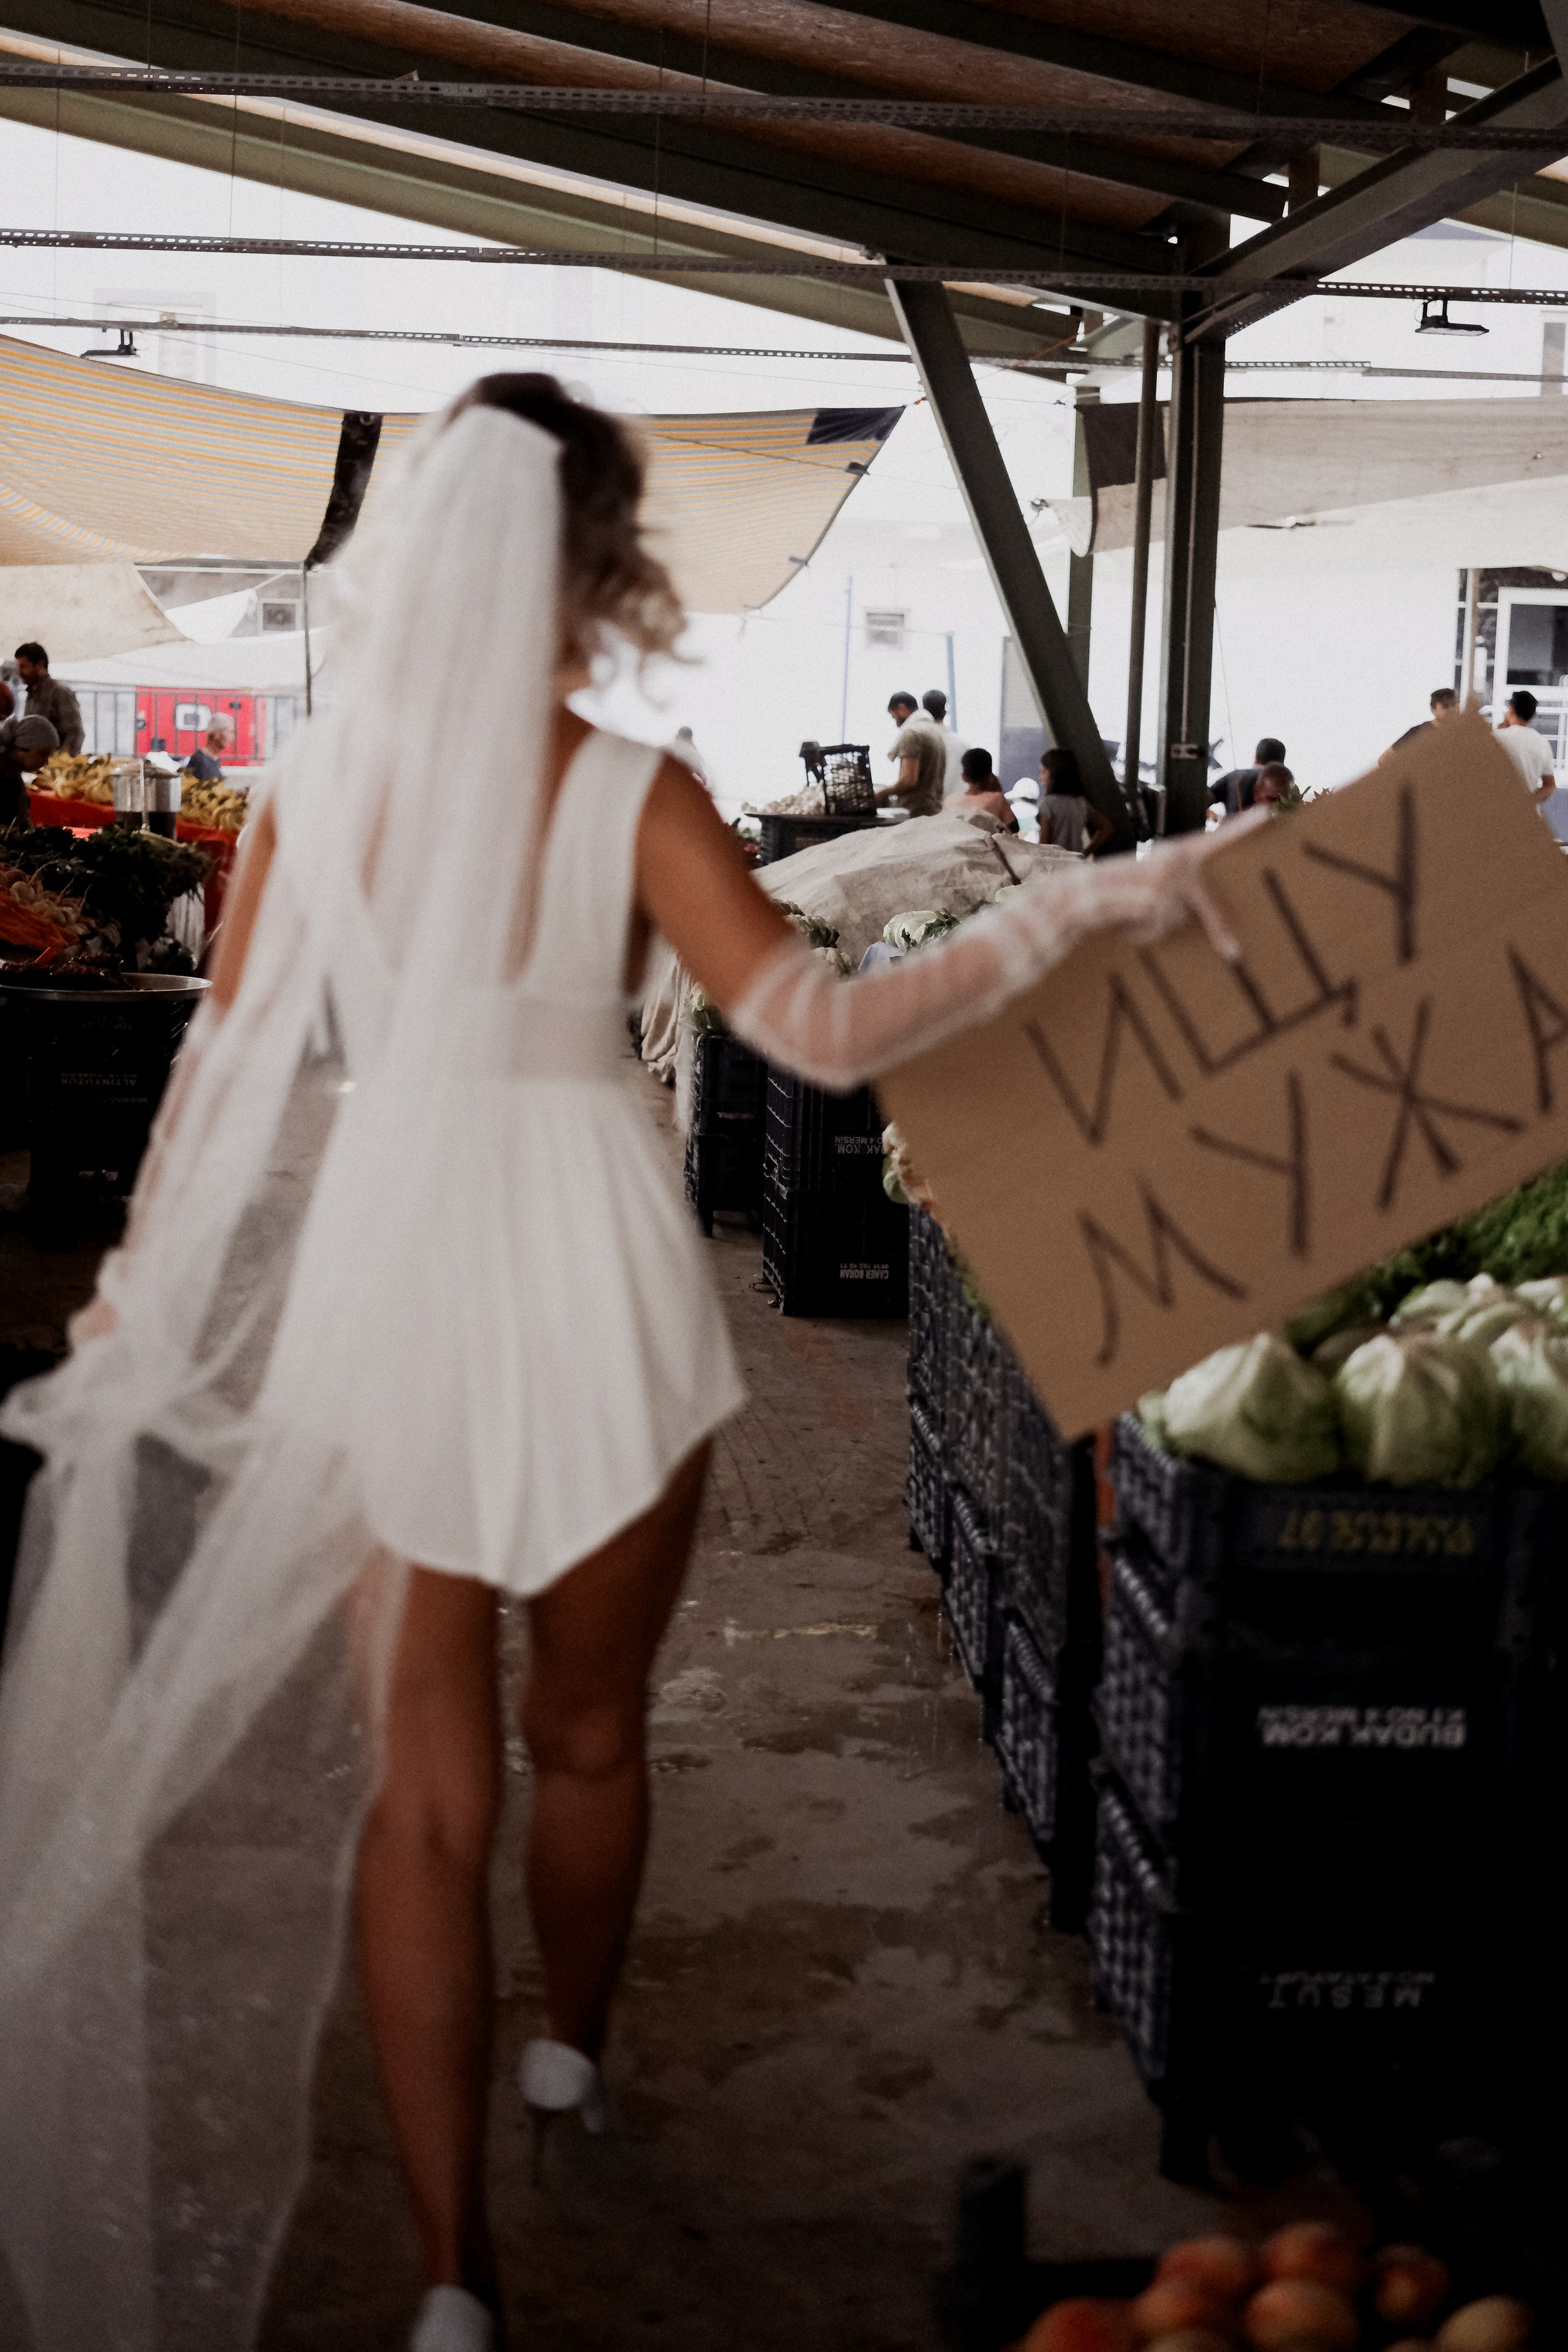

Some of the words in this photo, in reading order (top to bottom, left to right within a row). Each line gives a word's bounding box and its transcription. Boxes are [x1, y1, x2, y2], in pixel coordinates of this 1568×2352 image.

[1022, 782, 1422, 1148] ИЩУ
[840, 1268, 864, 1278] BORAN
[865, 1269, 889, 1279] CANER
